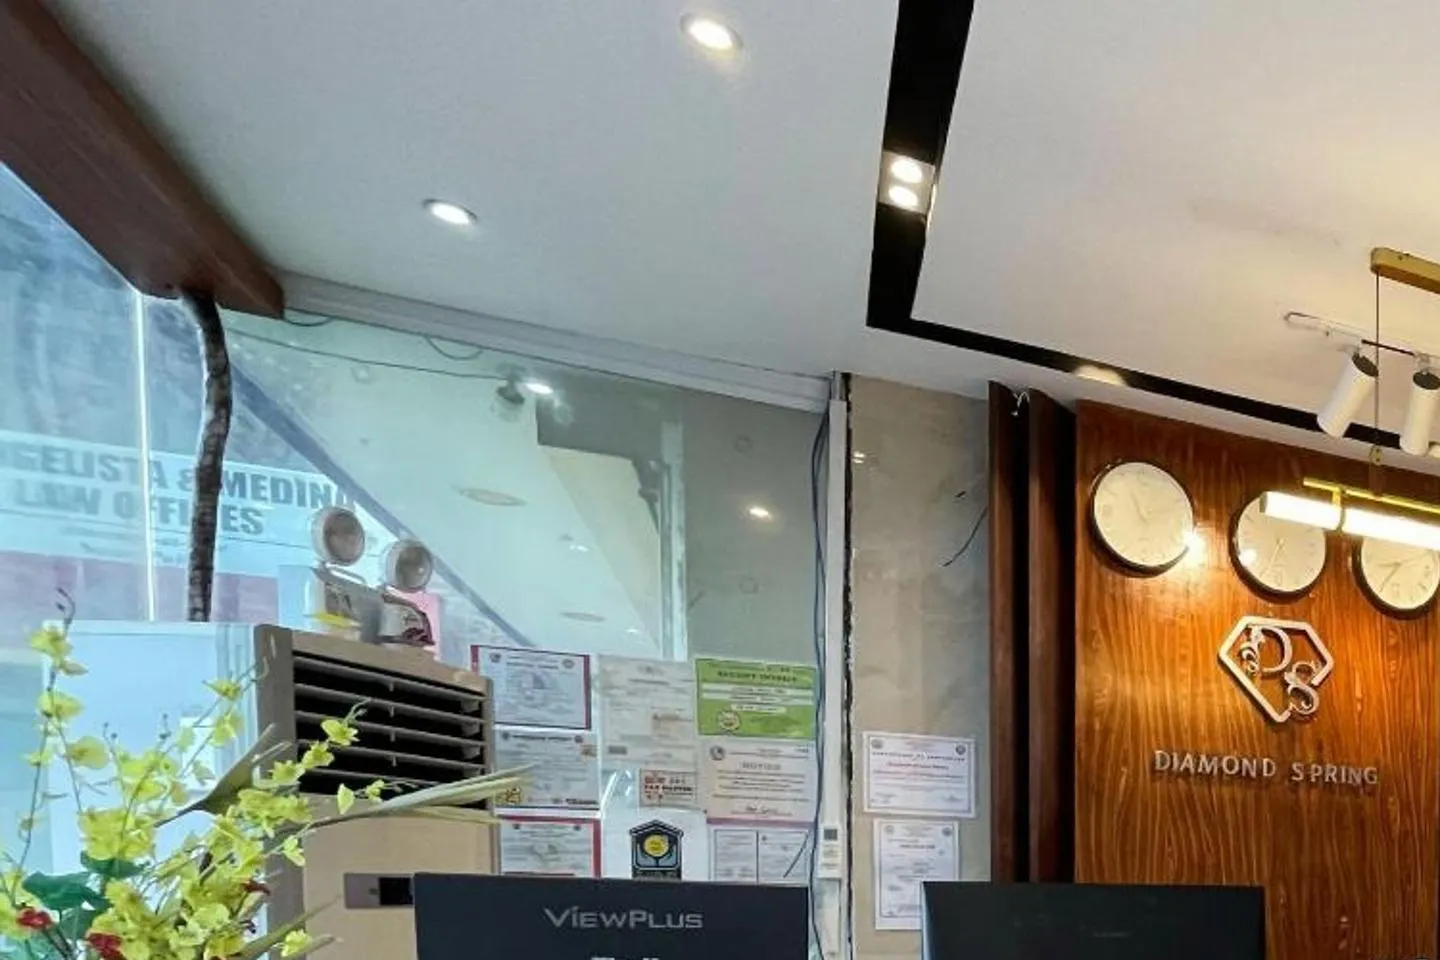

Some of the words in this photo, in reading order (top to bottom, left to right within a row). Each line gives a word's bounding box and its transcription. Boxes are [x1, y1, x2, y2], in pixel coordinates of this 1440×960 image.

[0, 443, 168, 489] GELISTA
[1155, 750, 1276, 777] DIAMOND
[1292, 762, 1378, 785] SPRING
